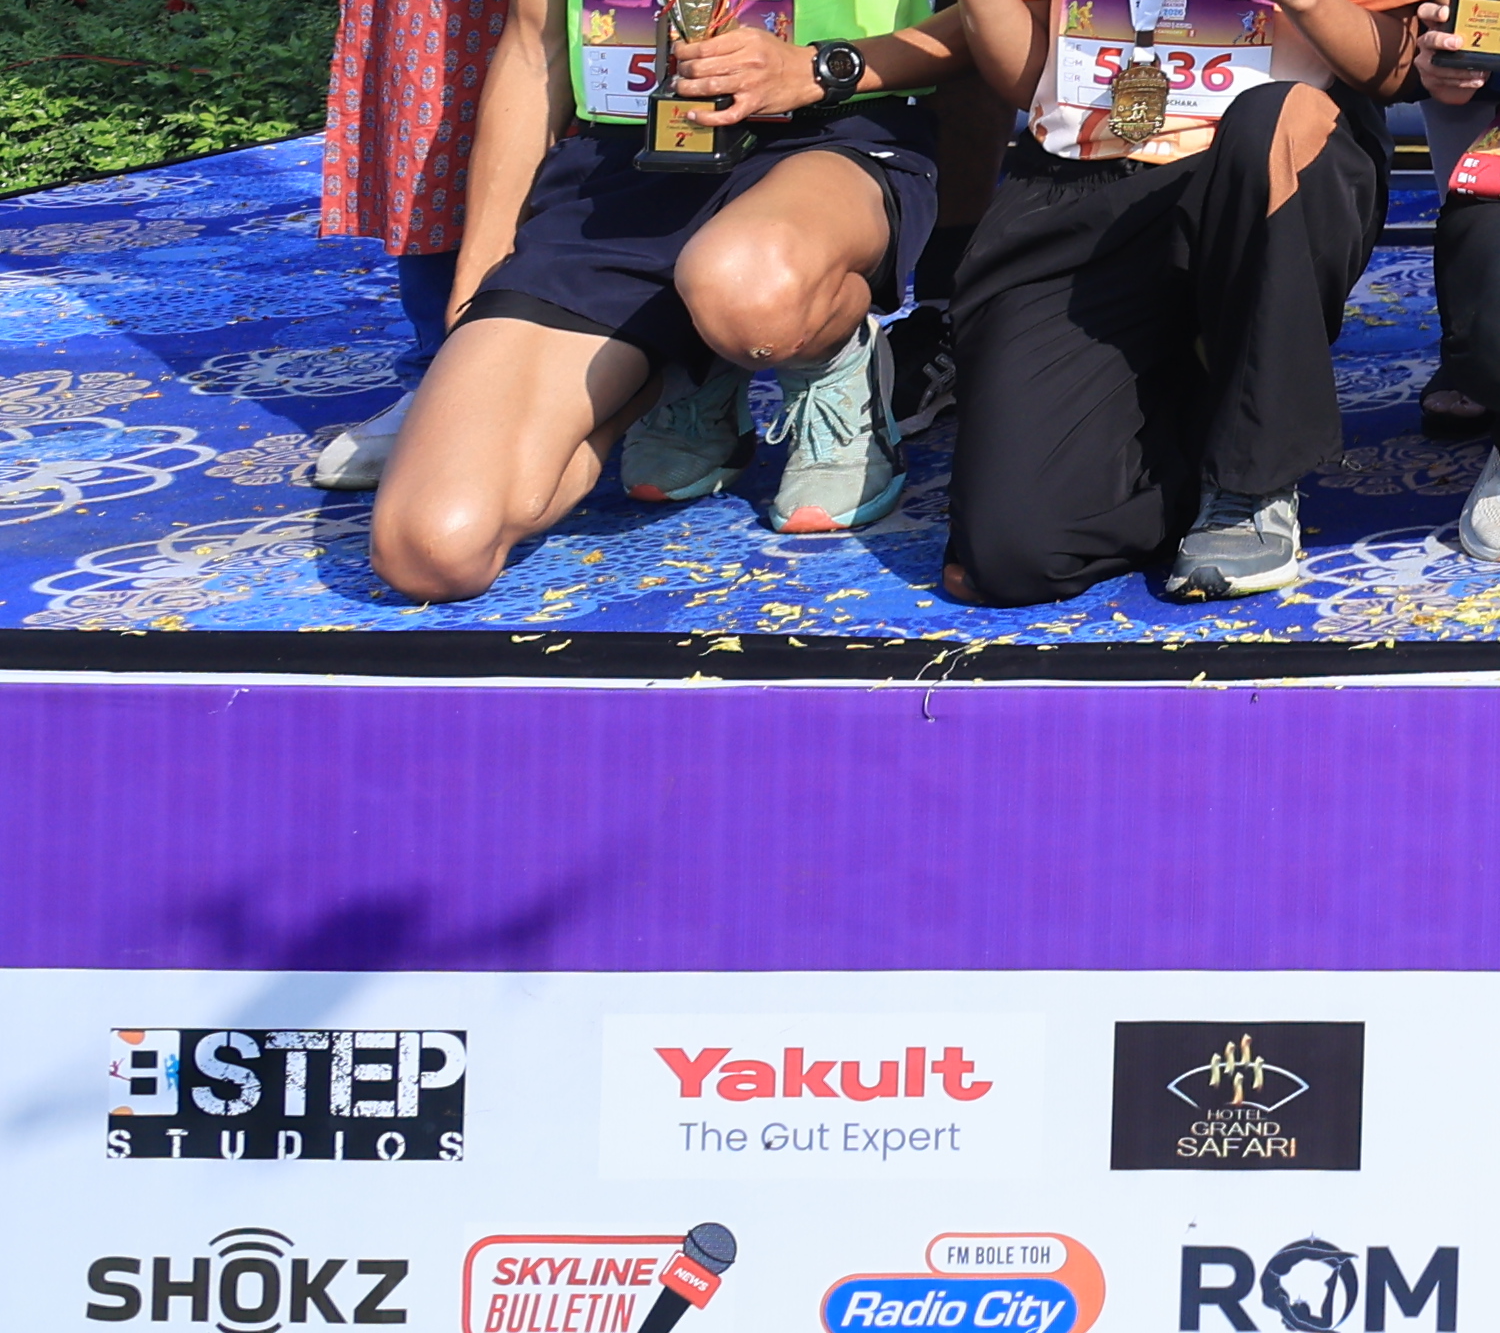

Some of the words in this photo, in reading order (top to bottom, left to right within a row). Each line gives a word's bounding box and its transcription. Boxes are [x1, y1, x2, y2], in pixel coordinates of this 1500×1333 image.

[1093, 46, 1234, 93] 536
[652, 1045, 995, 1101] Yakult
[1191, 1122, 1282, 1137] GRAND
[1207, 1109, 1267, 1121] HOTEL
[106, 1128, 464, 1161] STUDIOS
[679, 1120, 748, 1152] The
[762, 1120, 828, 1153] Gut
[840, 1119, 961, 1161] Expert
[1176, 1137, 1298, 1159] SAFARI
[946, 1245, 971, 1265] FM
[974, 1245, 1016, 1265] BOLE
[1020, 1245, 1052, 1265] TOH
[491, 1257, 656, 1287] SKYLINE
[673, 1265, 710, 1293] NEWS
[85, 1255, 410, 1325] SHOKZ
[484, 1292, 637, 1333] BULLETIN
[839, 1289, 964, 1329] Radio
[972, 1289, 1067, 1333] City
